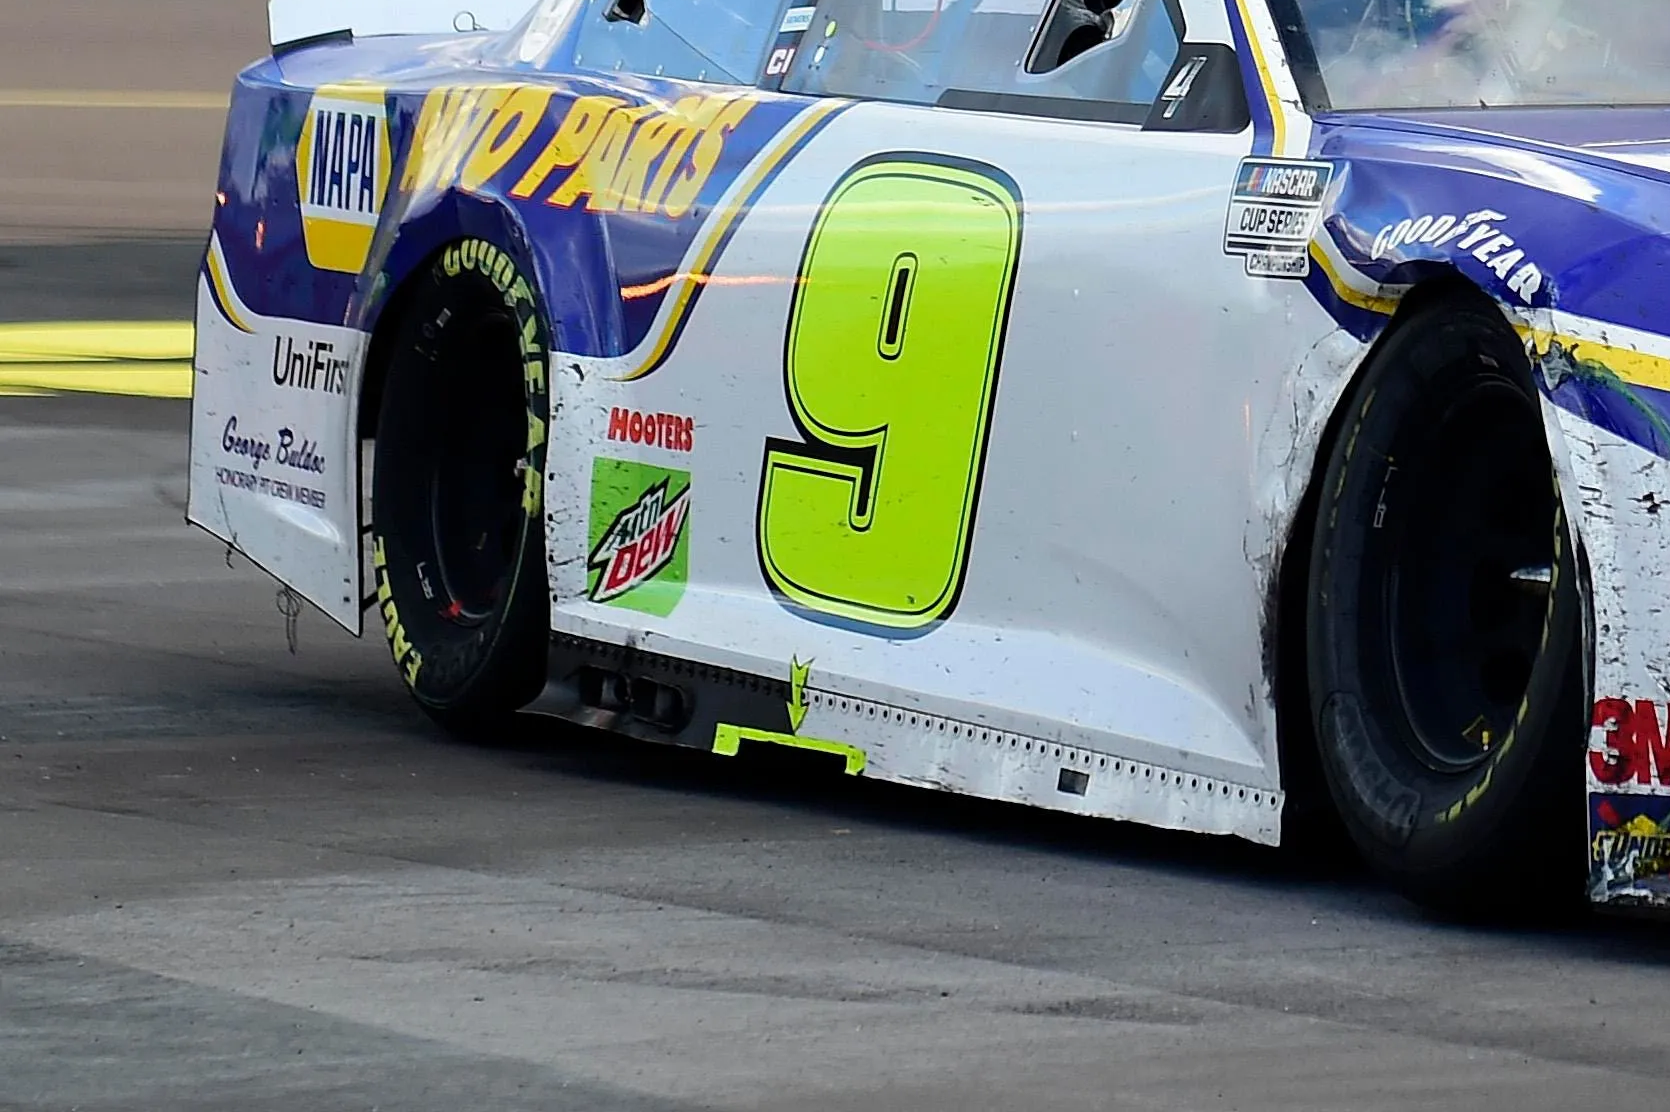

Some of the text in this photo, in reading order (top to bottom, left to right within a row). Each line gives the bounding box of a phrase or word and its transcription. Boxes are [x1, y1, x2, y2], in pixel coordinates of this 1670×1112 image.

[309, 108, 376, 214] NAPA
[508, 94, 758, 219] PARTS
[1262, 167, 1318, 197] NASCAR
[1240, 207, 1309, 235] CUP SERIES
[1370, 212, 1543, 305] GOODYEAR
[273, 335, 349, 396] UniFirs
[755, 151, 1024, 640] 9
[222, 415, 271, 469] George
[607, 406, 694, 452] HOOTERS
